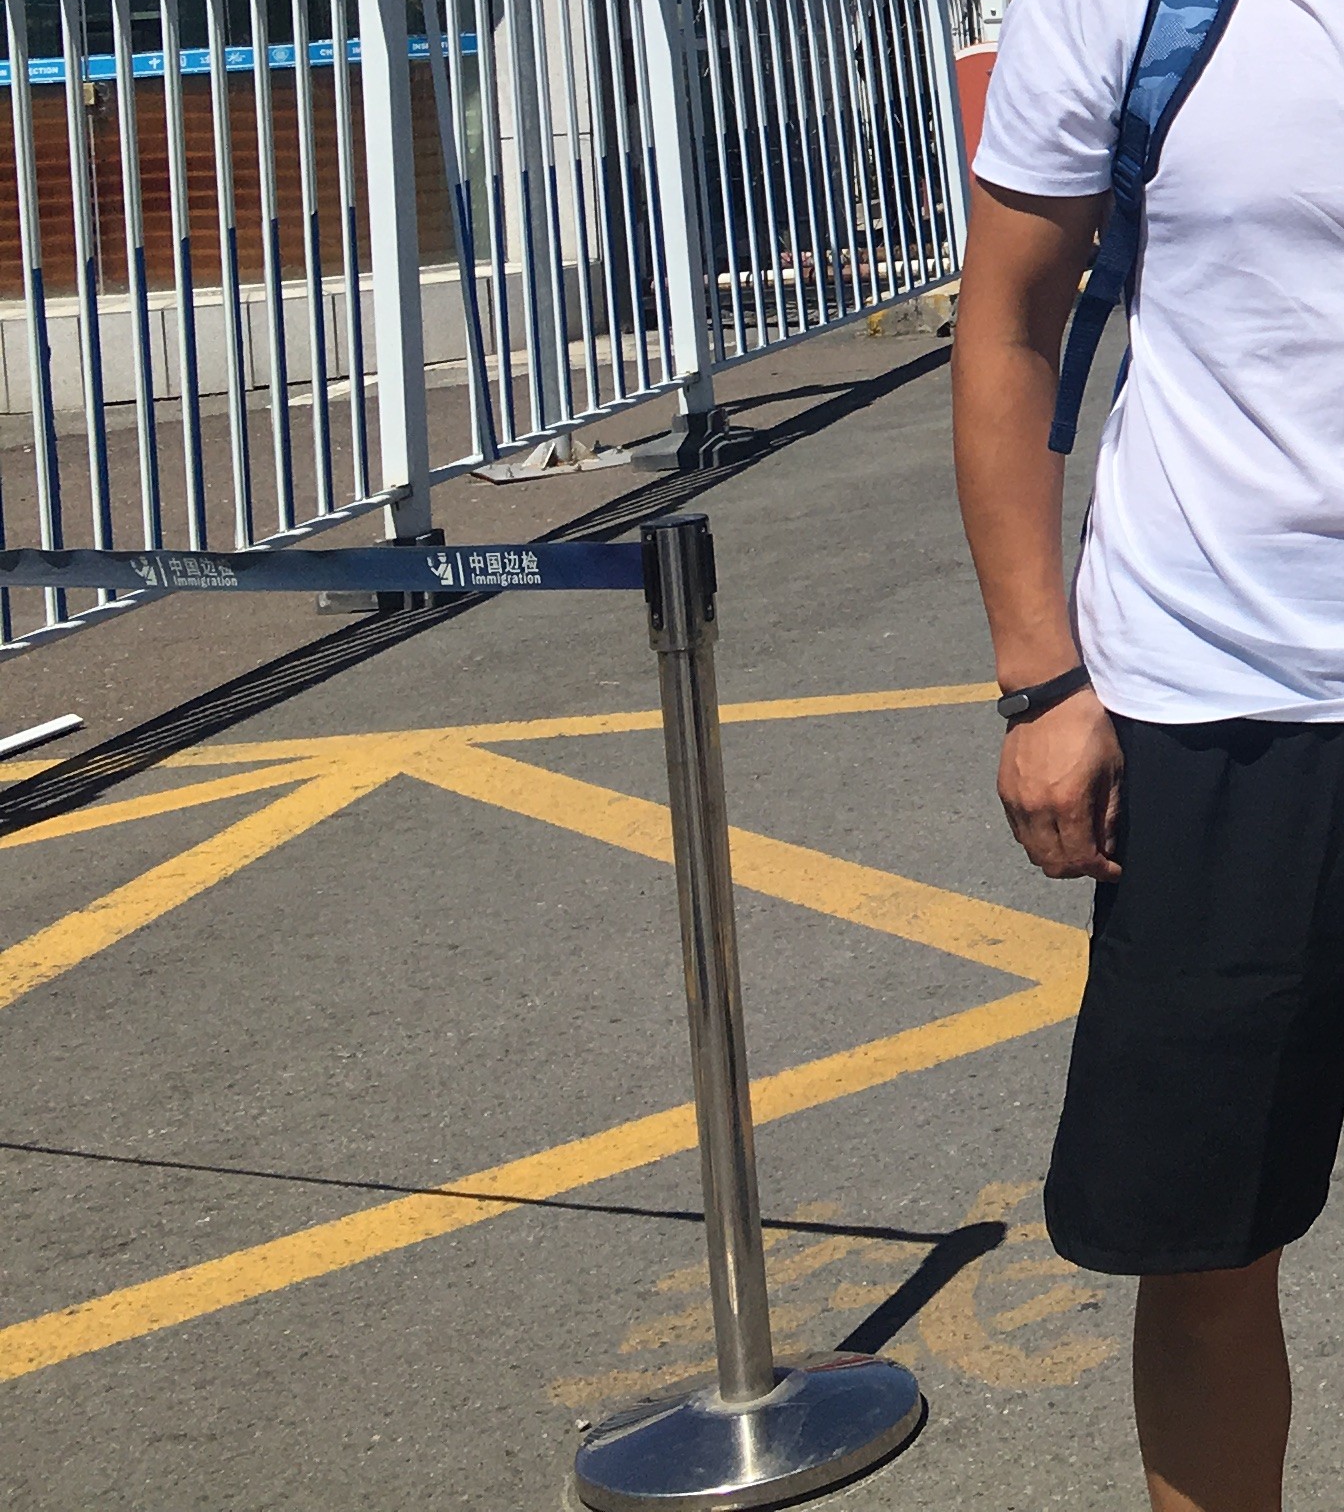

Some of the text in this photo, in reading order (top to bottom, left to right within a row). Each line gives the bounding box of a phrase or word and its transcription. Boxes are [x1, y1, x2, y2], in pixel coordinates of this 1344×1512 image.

[169, 556, 235, 577] 中国边检
[469, 551, 539, 574] 中国边检
[173, 575, 238, 588] Immigration
[471, 573, 541, 587] Immigration
